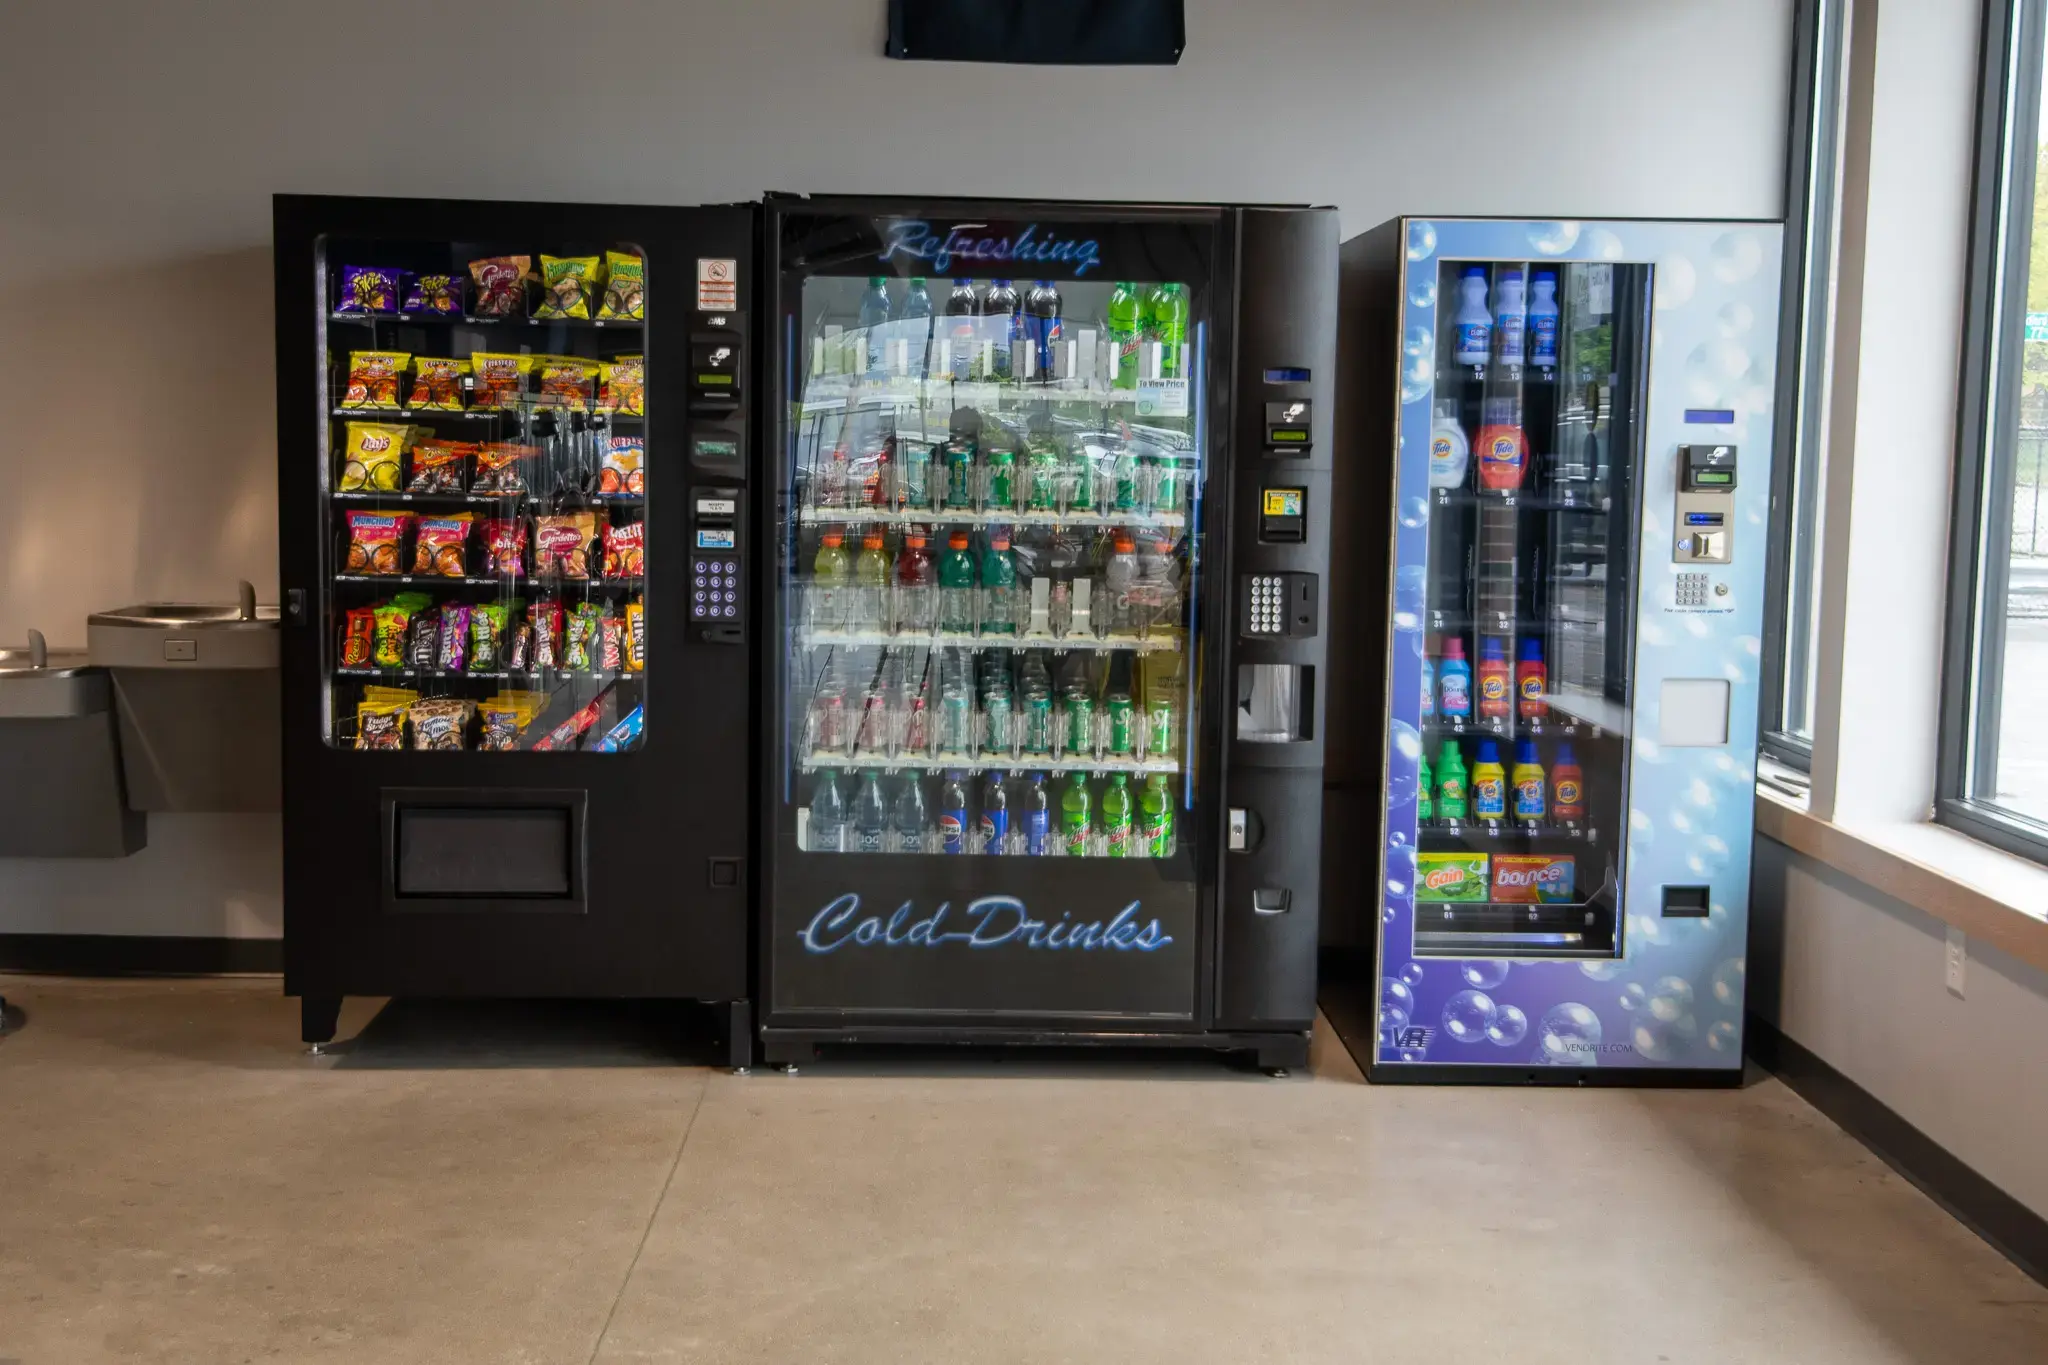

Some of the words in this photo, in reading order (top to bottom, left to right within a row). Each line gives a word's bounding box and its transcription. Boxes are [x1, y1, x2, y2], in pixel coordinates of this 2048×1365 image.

[879, 220, 1100, 277] Refreshing
[1475, 372, 1484, 380] 12
[1148, 380, 1165, 388] View
[1165, 380, 1185, 389] Price
[1433, 442, 1451, 455] Tide
[1494, 442, 1515, 454] Tide
[1564, 498, 1574, 506] 23
[1434, 620, 1443, 628] 31
[1485, 681, 1501, 693] Tide
[1524, 682, 1541, 694] Tide
[1559, 788, 1577, 799] Tide
[1489, 828, 1498, 836] 53
[1426, 869, 1464, 889] Gain
[1496, 866, 1561, 887] bounce
[798, 893, 958, 954] Cold
[966, 893, 1174, 952] Drinks
